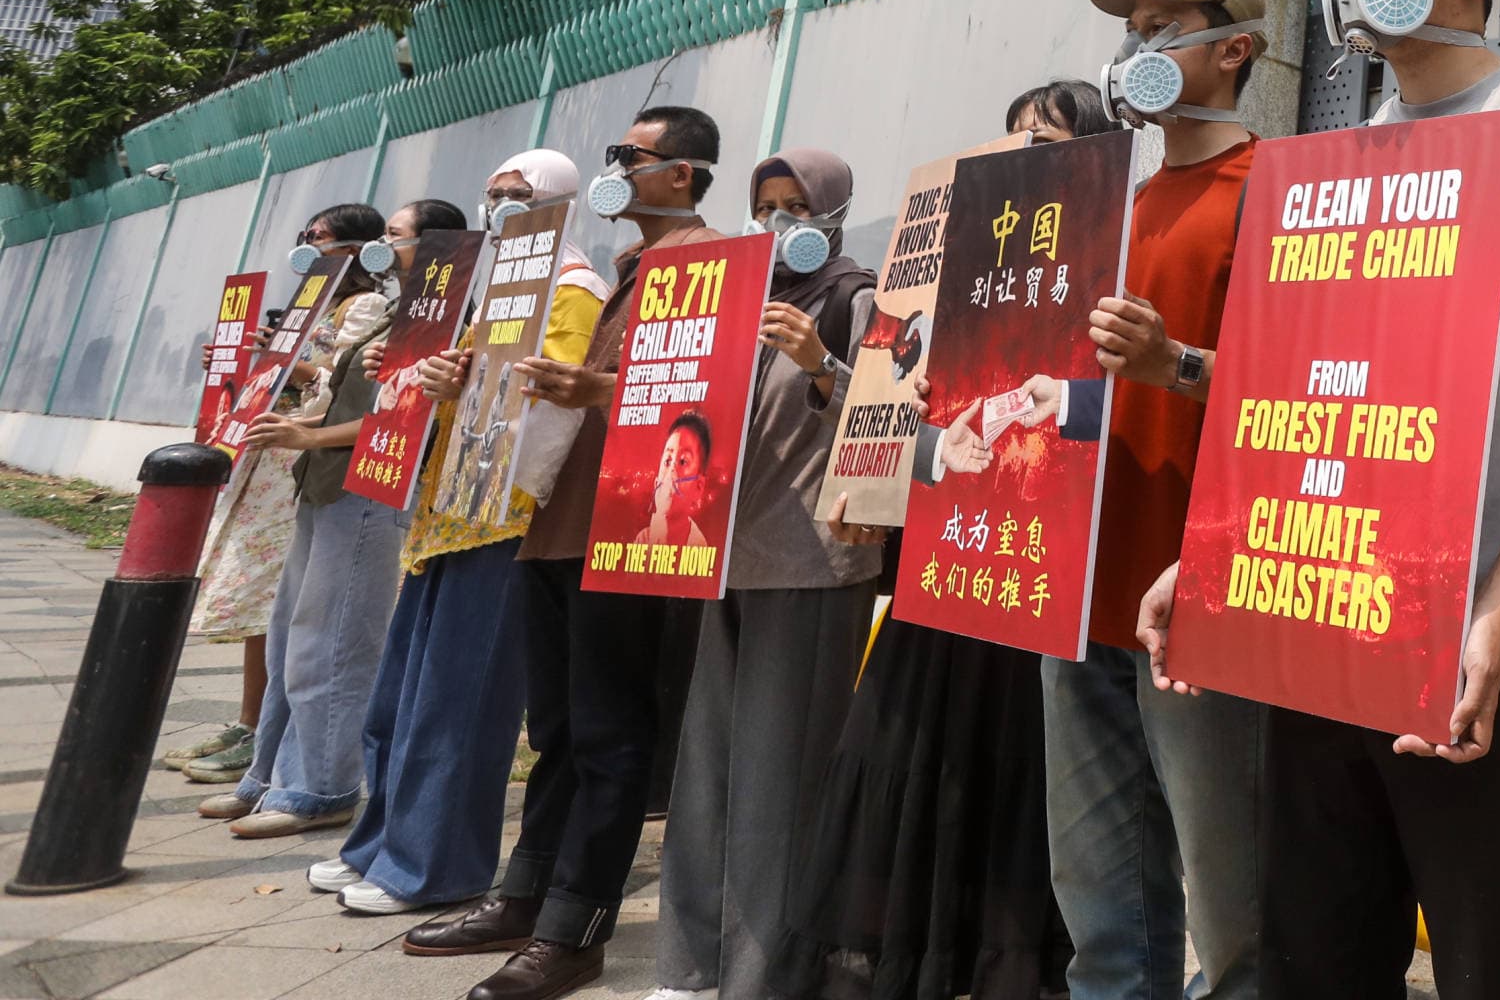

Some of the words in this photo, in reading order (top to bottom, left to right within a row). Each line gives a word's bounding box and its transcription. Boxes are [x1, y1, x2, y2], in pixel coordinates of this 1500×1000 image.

[905, 188, 942, 225] TOXIC
[1282, 177, 1372, 229] CLEAN
[1381, 169, 1462, 223] YOUR
[894, 218, 940, 259] KNOWS
[992, 200, 1062, 267] 中国
[1269, 232, 1357, 281] TRADE
[1363, 226, 1460, 279] CHAIN
[422, 257, 454, 297] 中国
[640, 260, 726, 321] 63.711
[884, 252, 941, 294] BORDERS
[971, 265, 1069, 308] 别让贸易
[631, 317, 716, 361] CHILDREN
[622, 382, 649, 404] ACUTE
[651, 380, 708, 403] RESPIRATORY
[626, 363, 669, 384] SUFFERING
[672, 361, 698, 380] FROM
[1308, 361, 1369, 396] FROM
[618, 405, 661, 425] INFECTION
[844, 403, 895, 438] NEITHER
[1235, 399, 1342, 455] FOREST
[1347, 404, 1437, 462] FIRES
[834, 442, 903, 477] SOLIDARITY
[1301, 459, 1345, 497] AND
[940, 504, 1046, 563] 成为窒息
[1244, 497, 1380, 567] CLIMATE
[592, 542, 622, 570] STOP
[625, 544, 648, 572] THE
[649, 544, 677, 574] FIRE
[679, 546, 716, 576] NOW!
[921, 551, 1050, 617] 我们的推手
[1227, 554, 1393, 634] DISASTERS
